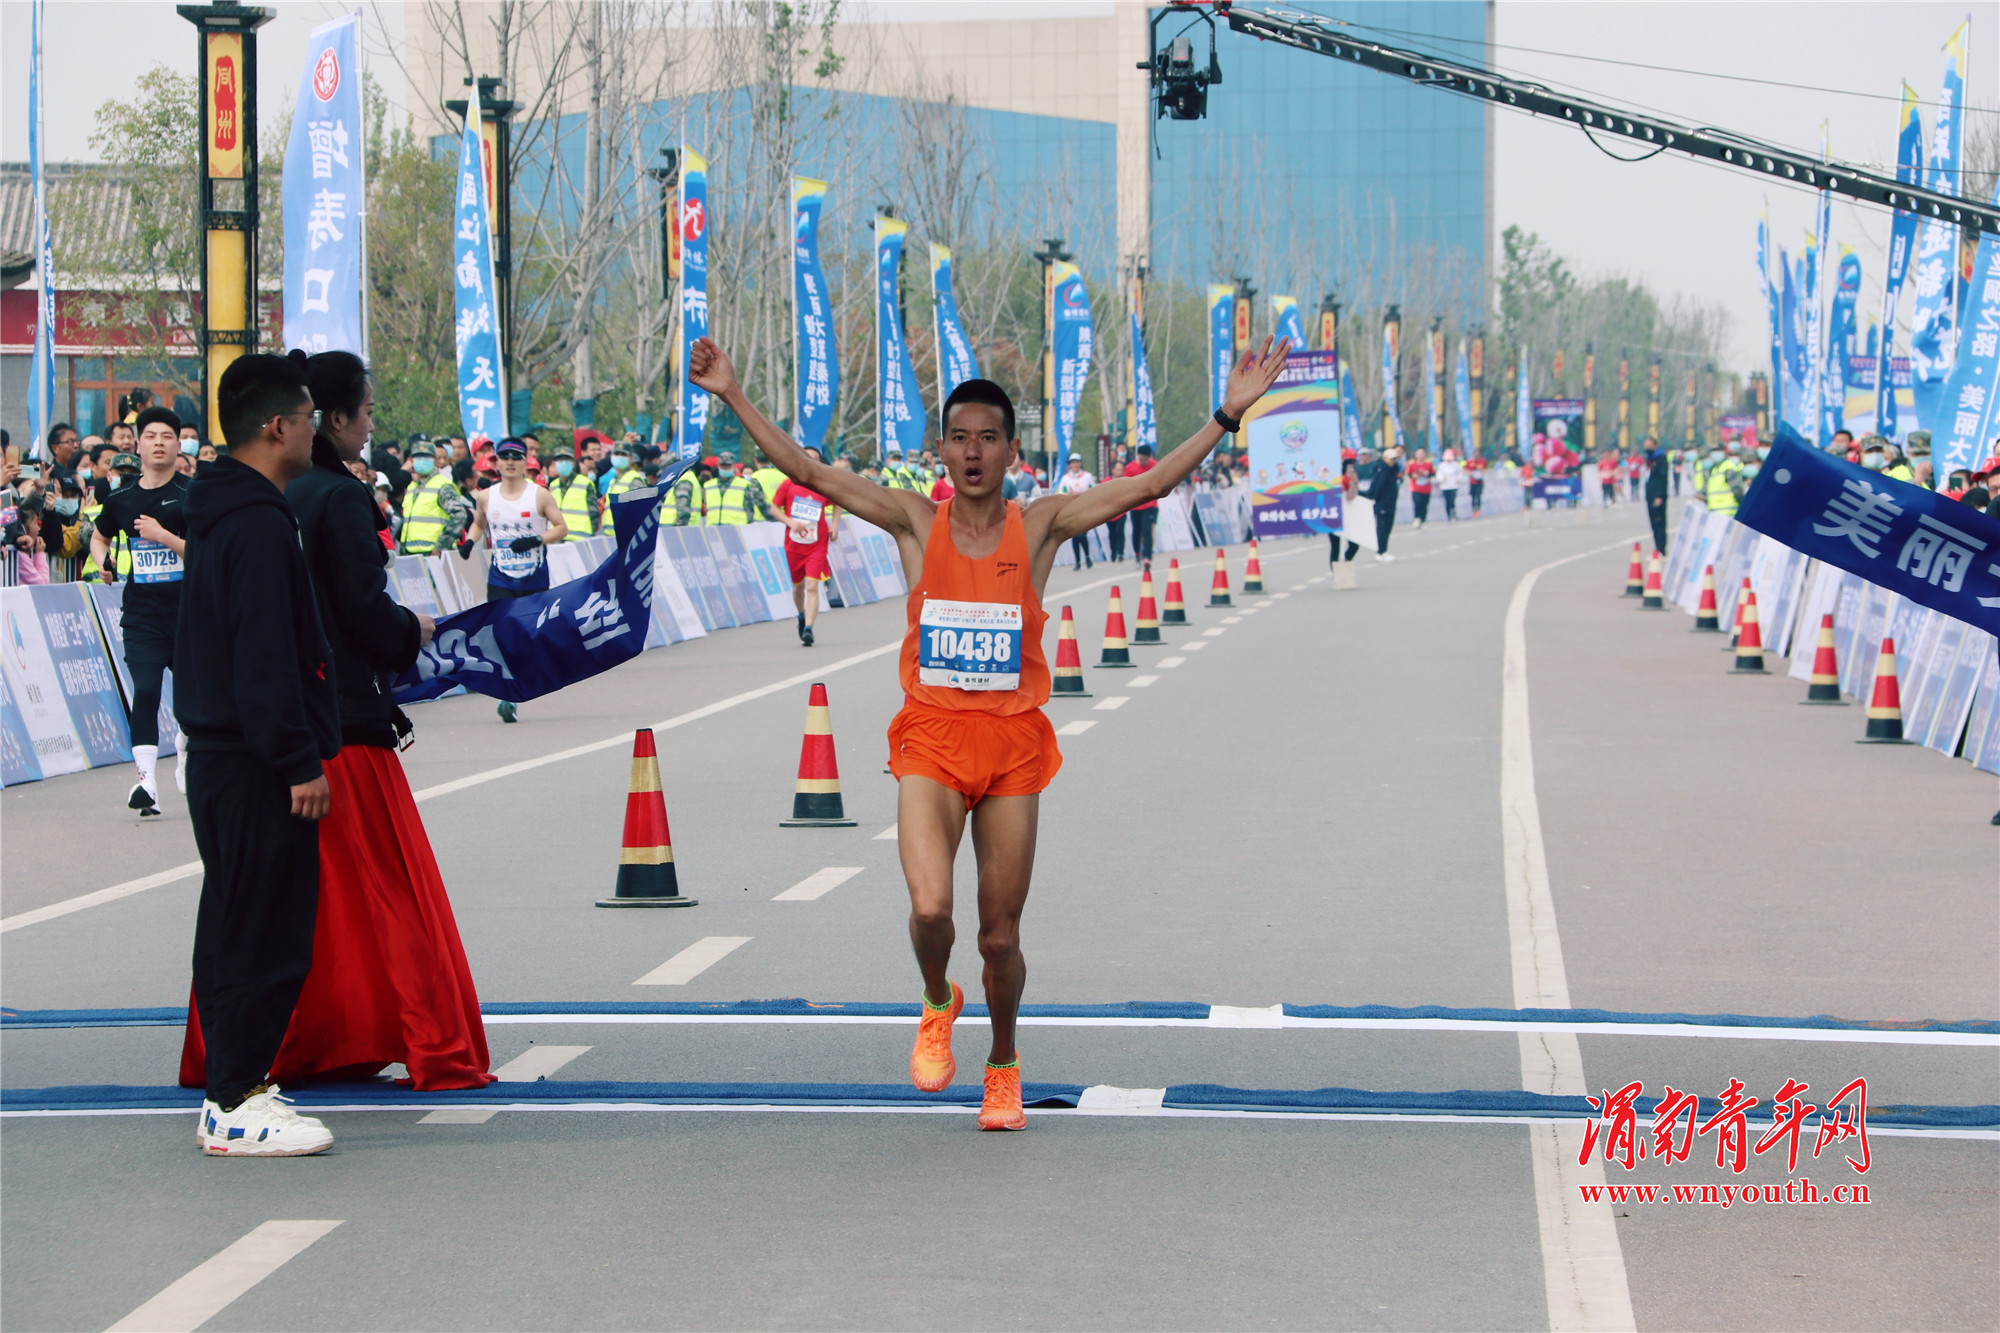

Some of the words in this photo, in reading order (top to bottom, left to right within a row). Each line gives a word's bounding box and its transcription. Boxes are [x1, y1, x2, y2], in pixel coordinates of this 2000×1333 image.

[137, 551, 178, 567] 30729
[1813, 478, 2000, 608] 美丽
[928, 629, 1012, 662] 10438
